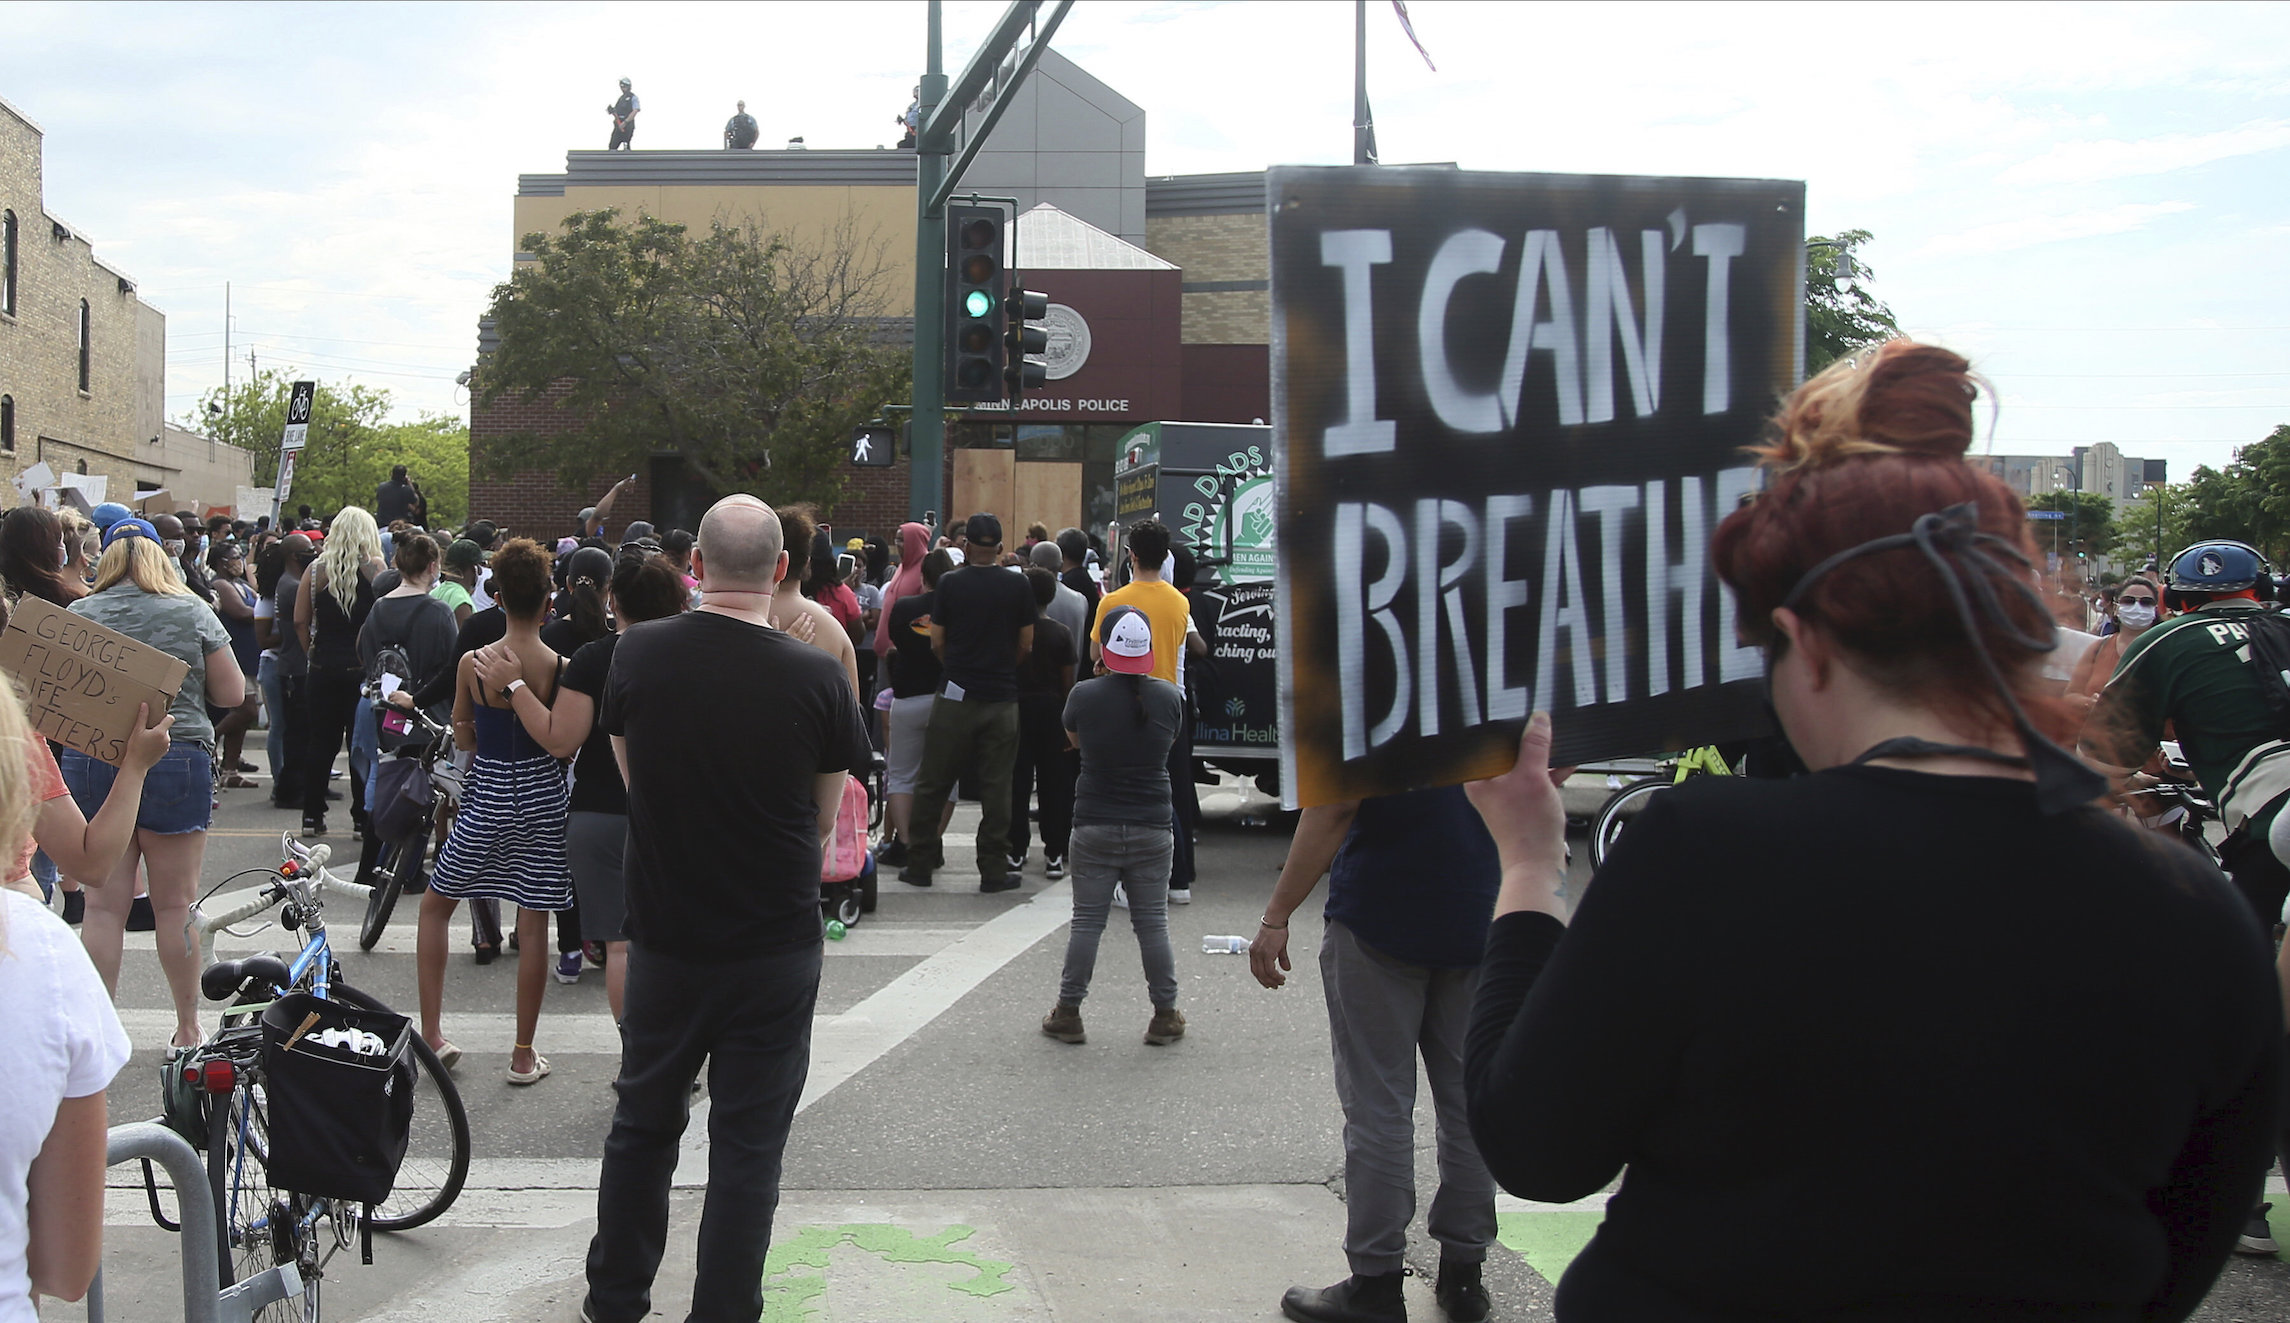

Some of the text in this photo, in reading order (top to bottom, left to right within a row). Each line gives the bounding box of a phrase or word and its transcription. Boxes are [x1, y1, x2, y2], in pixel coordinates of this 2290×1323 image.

[1320, 207, 1747, 459] I CAN'T
[1079, 400, 1129, 411] POLICE
[1193, 445, 1264, 500] DADS
[1333, 467, 1766, 762] BREATHE
[2206, 622, 2250, 646] PA
[37, 614, 137, 673] GEORGE
[1214, 642, 1256, 664] ching
[22, 703, 126, 761] ATTERS
[1193, 721, 1230, 741] llina
